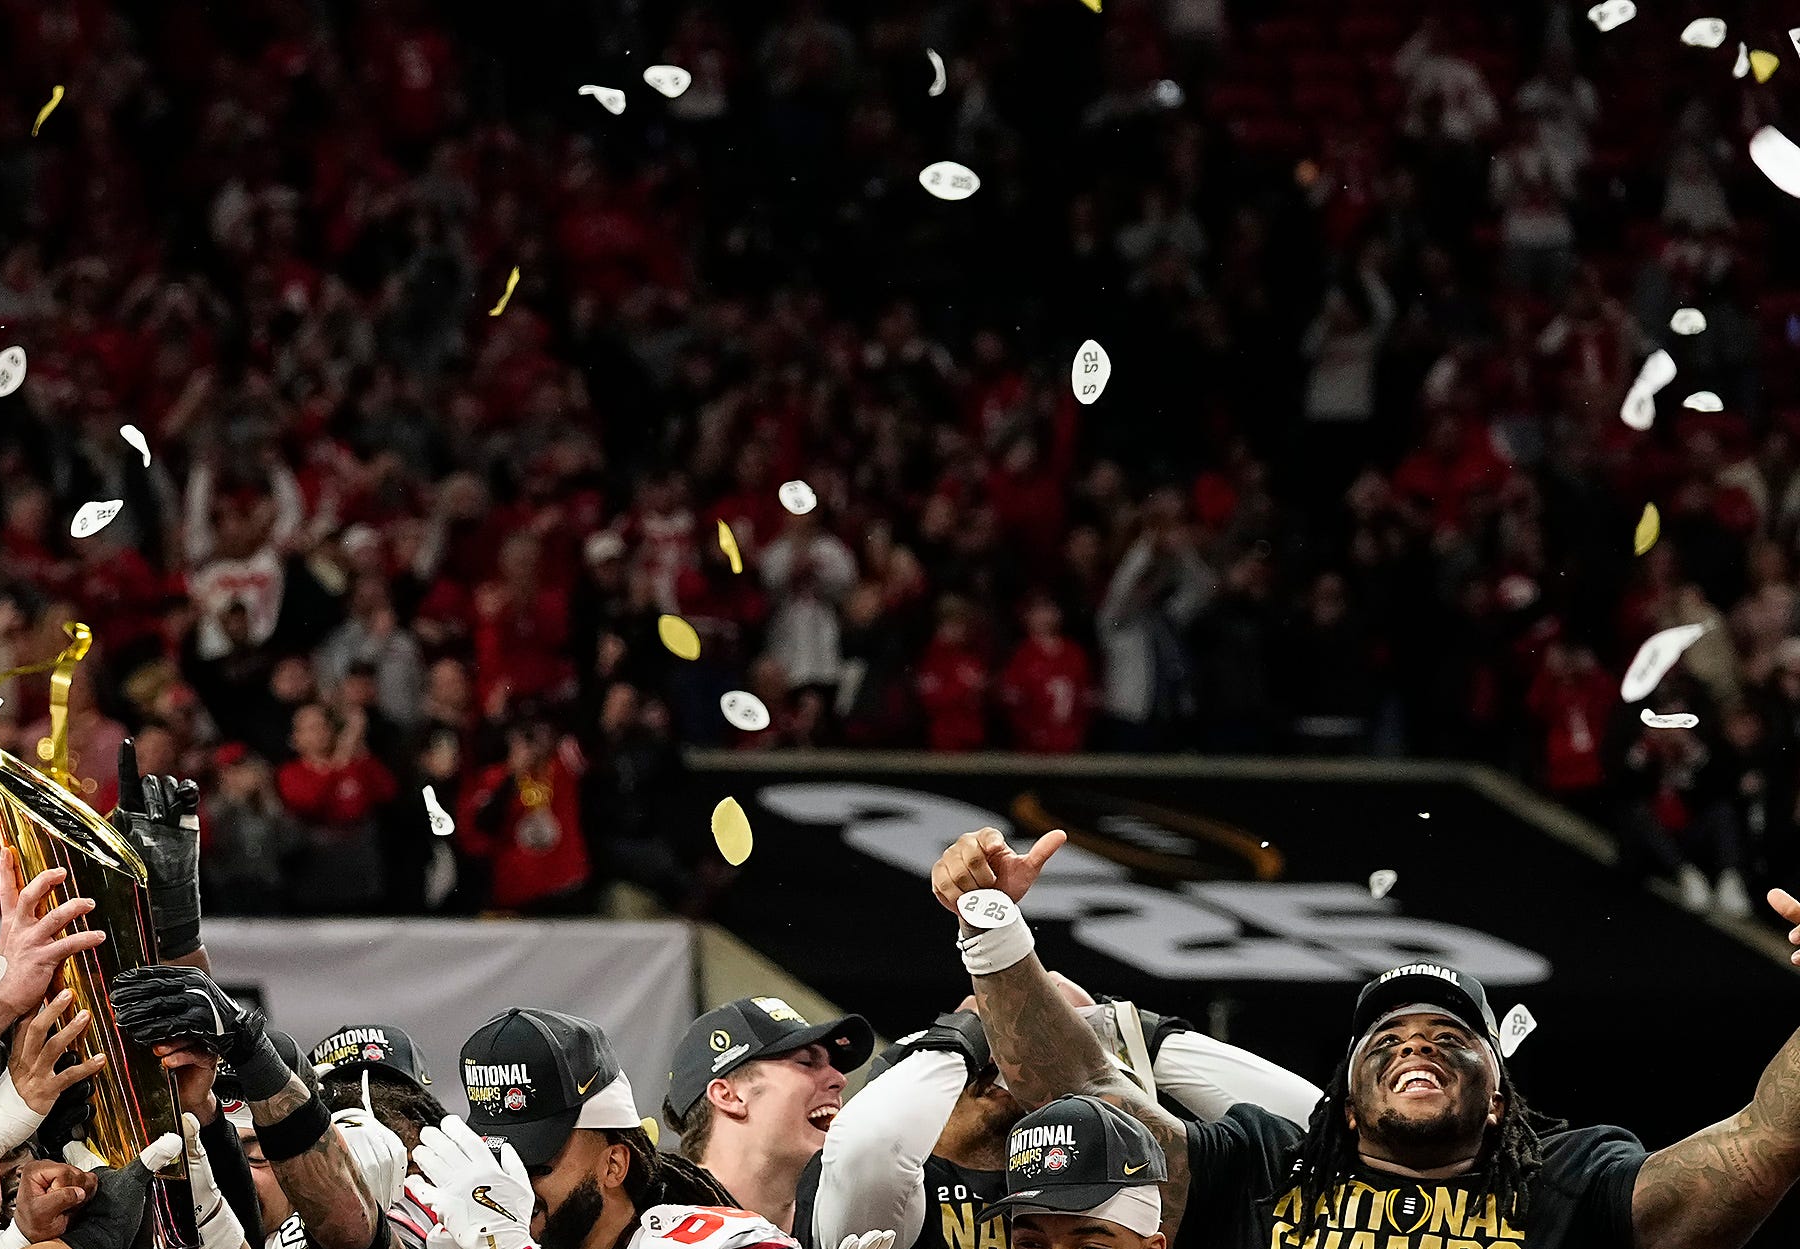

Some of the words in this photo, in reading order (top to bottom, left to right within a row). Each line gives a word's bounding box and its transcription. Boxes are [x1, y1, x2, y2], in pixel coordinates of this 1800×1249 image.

[313, 1028, 389, 1063] NATIONAL
[464, 1063, 531, 1087] NATIONAL
[467, 1086, 501, 1102] CHAMPS
[1009, 1125, 1077, 1158] NATIONAL
[1008, 1148, 1043, 1172] CHAMPS
